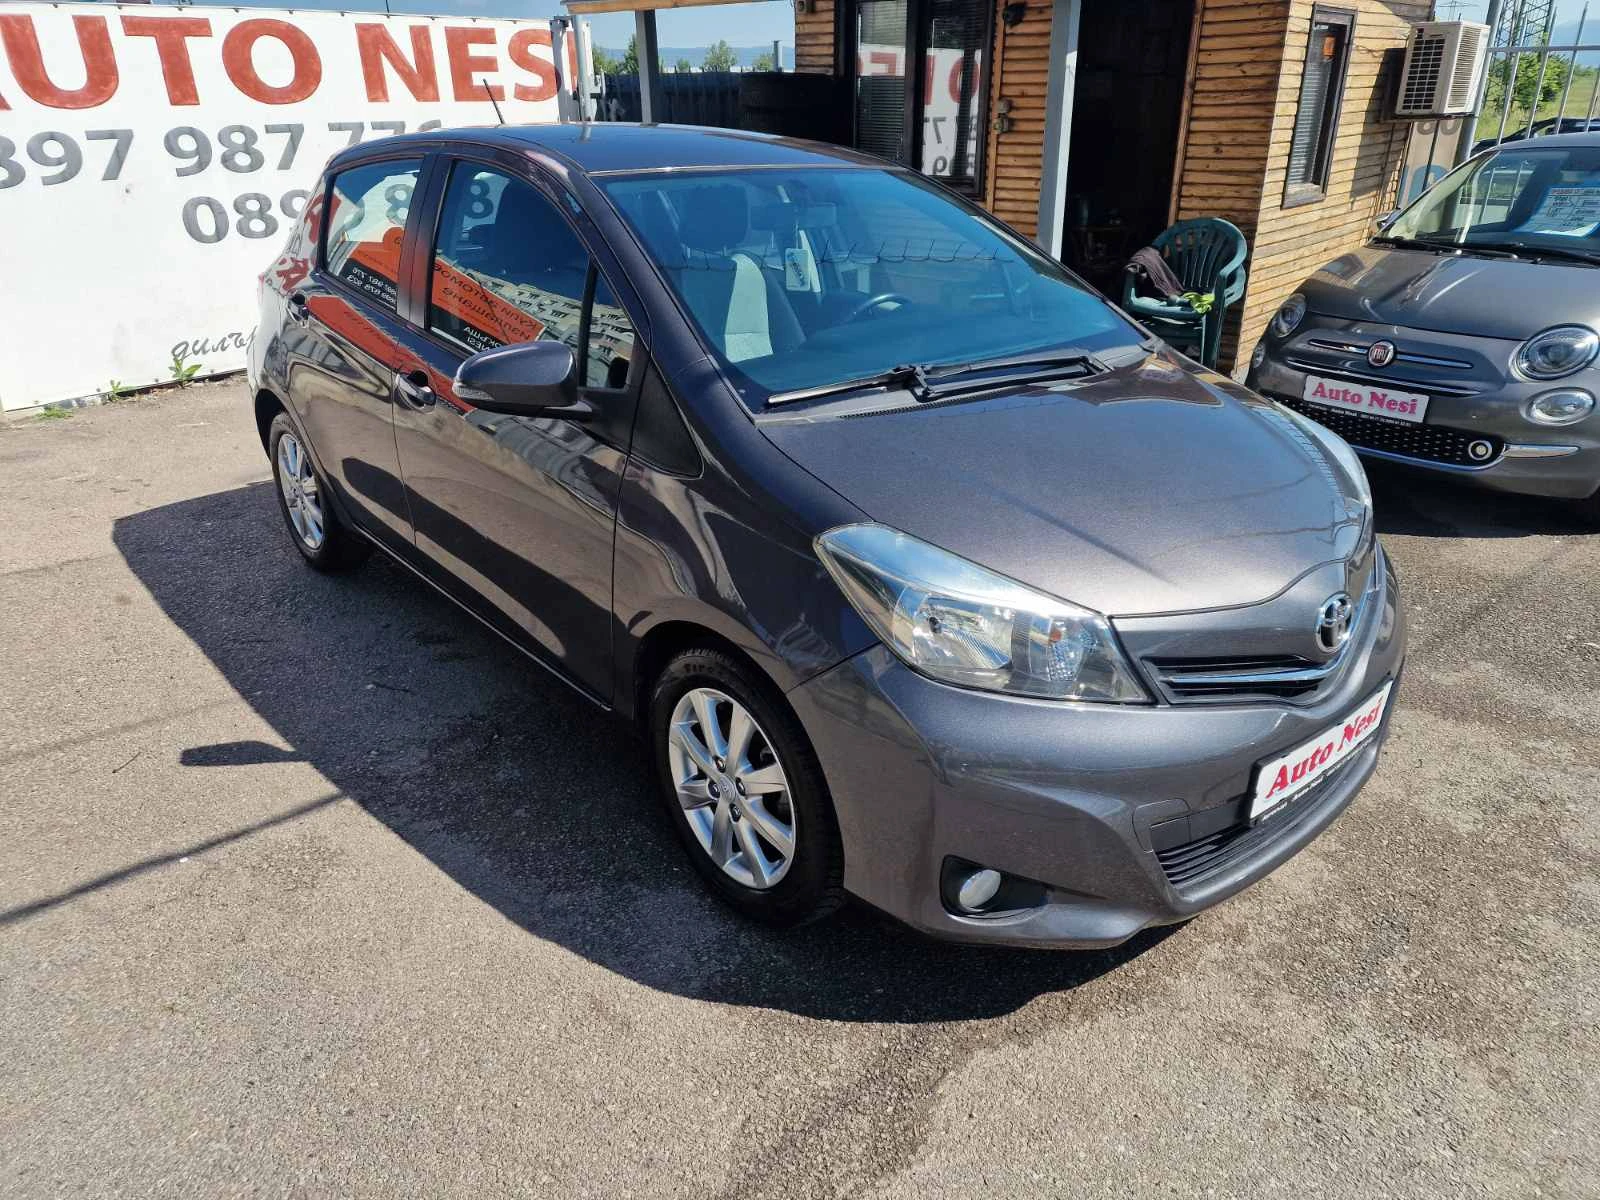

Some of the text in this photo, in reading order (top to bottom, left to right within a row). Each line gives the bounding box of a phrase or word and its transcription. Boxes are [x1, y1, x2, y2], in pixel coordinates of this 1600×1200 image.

[0, 14, 322, 110] UTO
[163, 123, 305, 177] 987
[1312, 382, 1418, 415] Auto Nesi
[1265, 742, 1334, 799] Auto
[1337, 695, 1384, 752] Nesi
